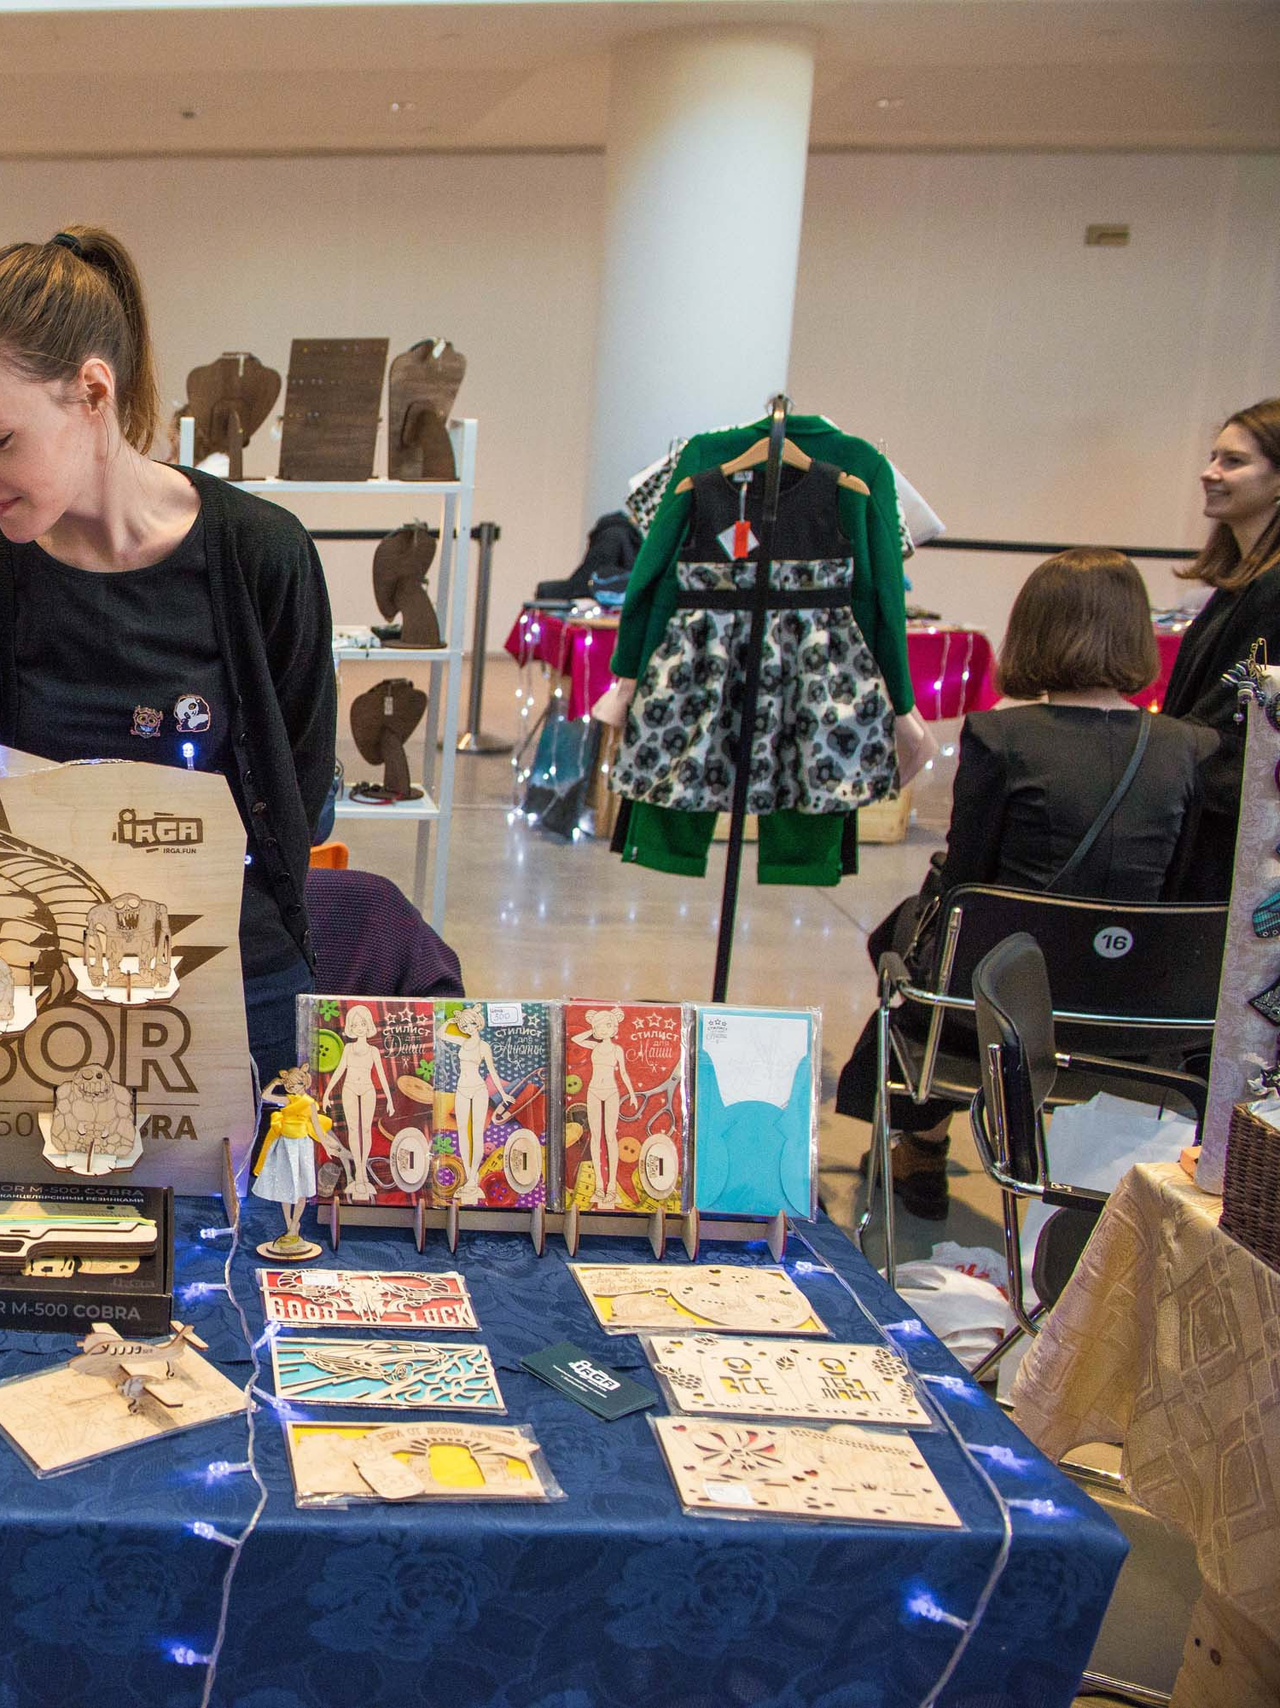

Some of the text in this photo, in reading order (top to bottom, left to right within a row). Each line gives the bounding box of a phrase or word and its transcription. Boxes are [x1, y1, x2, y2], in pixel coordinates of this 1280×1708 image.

[1102, 934, 1127, 950] 16
[84, 1187, 145, 1197] COBRA
[12, 1302, 68, 1318] M-500
[73, 1304, 141, 1321] COBRA
[271, 1296, 477, 1326] GOOD LUCK
[720, 1375, 777, 1396] ВСЕ
